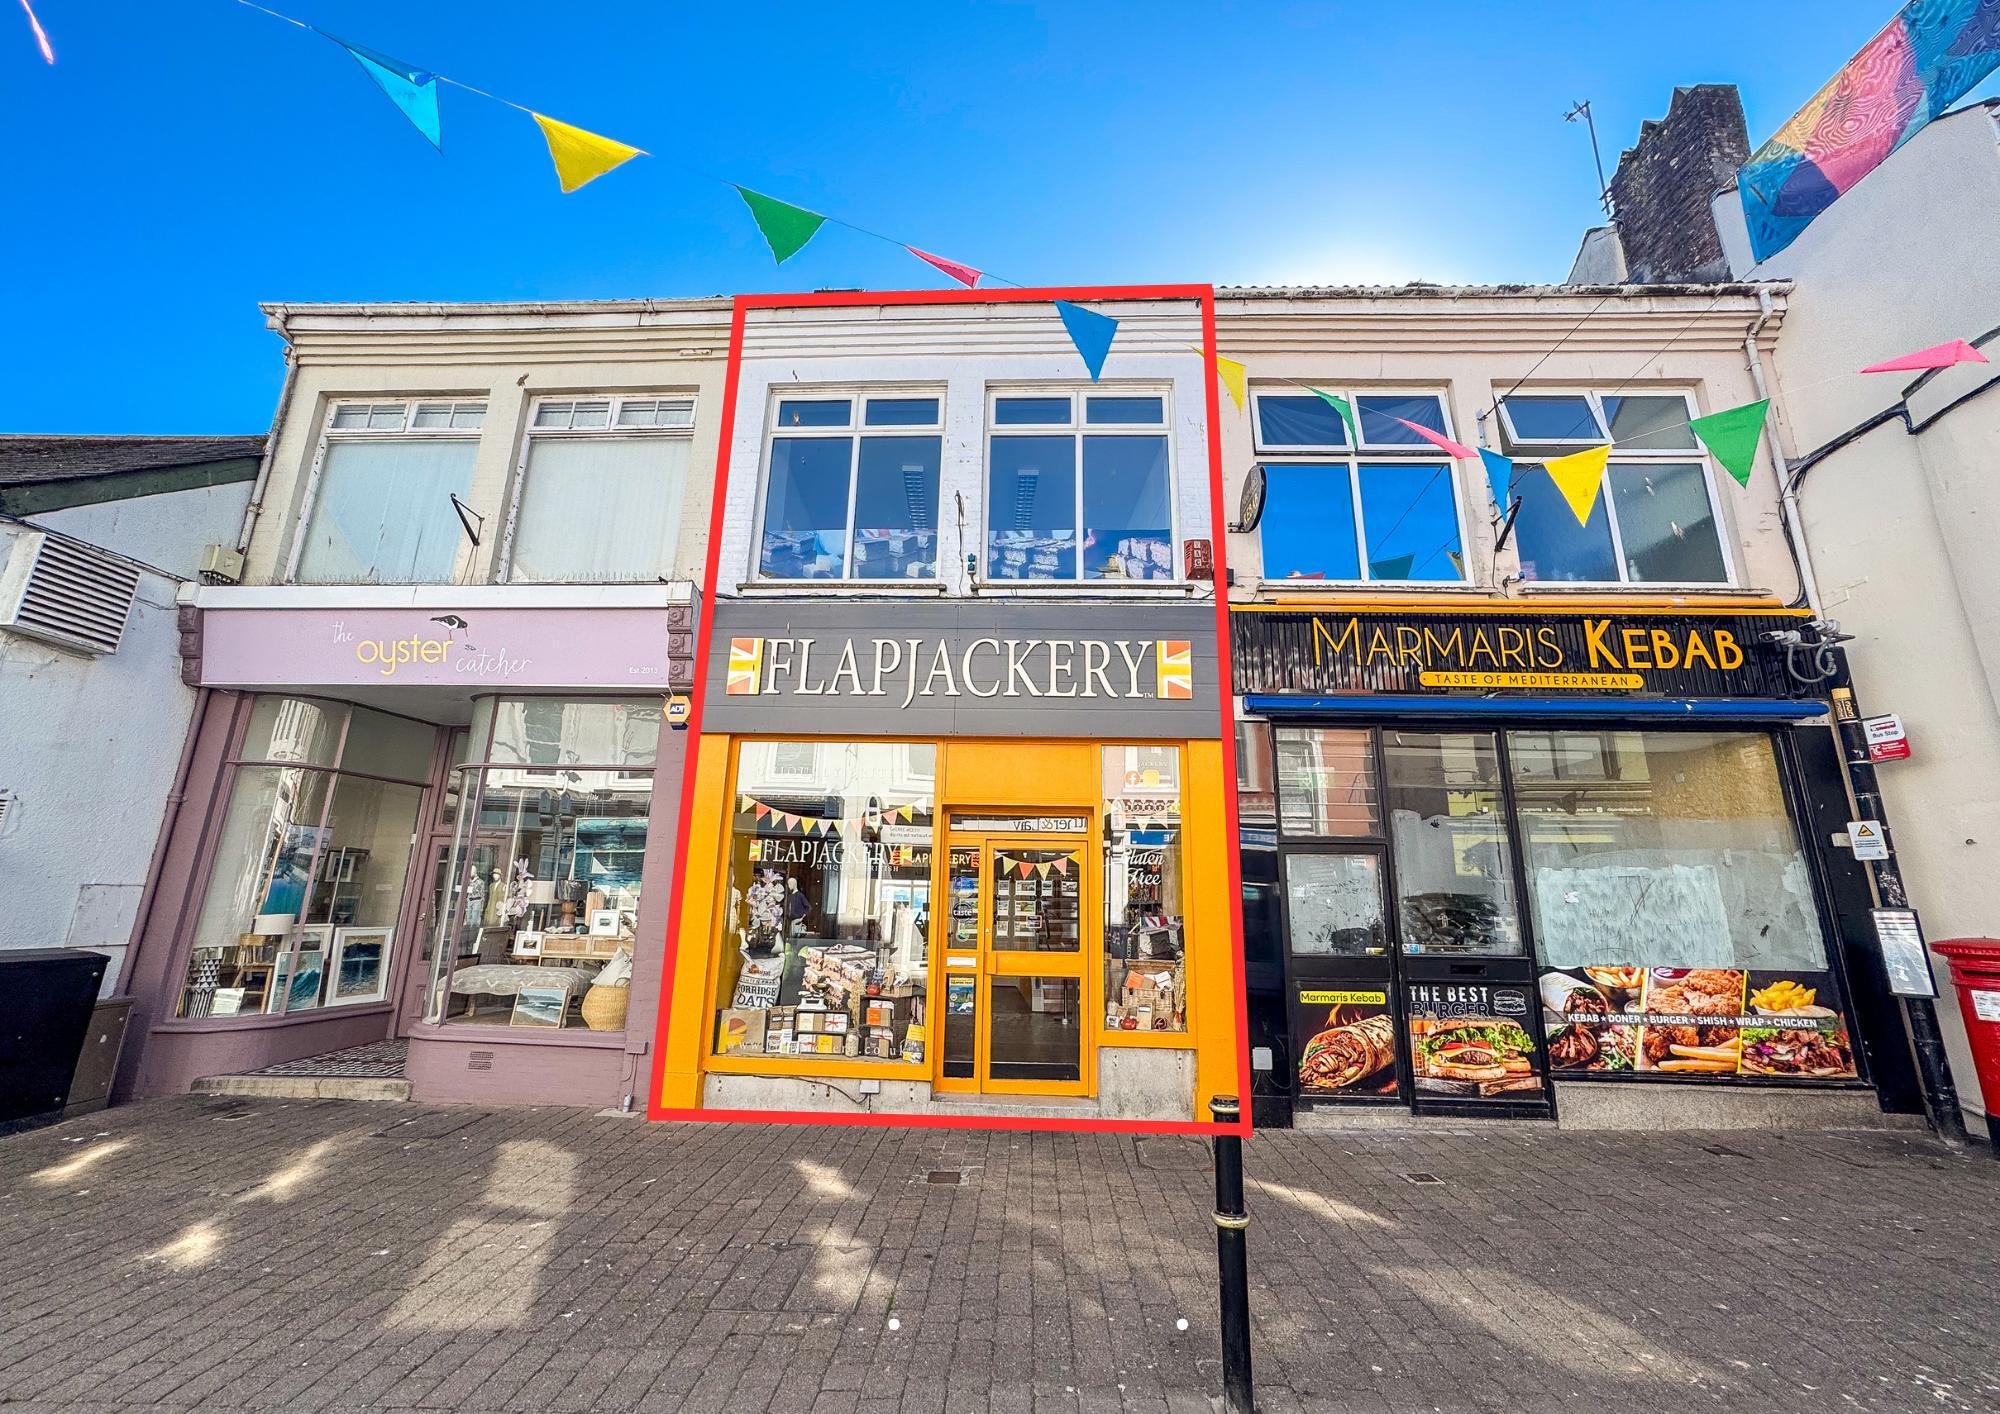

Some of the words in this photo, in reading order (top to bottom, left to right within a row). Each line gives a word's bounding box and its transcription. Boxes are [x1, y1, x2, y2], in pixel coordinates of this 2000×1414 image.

[332, 621, 354, 644] the
[1312, 616, 1563, 668] MARMARIS
[1583, 619, 1744, 671] KEBAB
[355, 633, 454, 676] oyster
[455, 647, 534, 677] catcher
[762, 638, 1152, 710] FLAPJACKERY
[1434, 673, 1478, 685] TASTE
[1483, 674, 1502, 685] OF
[1508, 674, 1630, 687] MEDITERRANEAN
[670, 704, 685, 713] ADT
[1127, 868, 1162, 886] Free
[1301, 993, 1348, 1003] Marmaris
[1350, 993, 1382, 1003] Kebab
[1409, 985, 1441, 1002] THE
[1447, 986, 1488, 1003] BEST
[1410, 1001, 1491, 1018] BURGER
[1567, 1013, 1600, 1023] KEBAB
[1608, 1014, 1642, 1024] DONER
[1649, 1015, 1688, 1025] BURGER
[1697, 1016, 1727, 1026] SHISH
[1735, 1017, 1765, 1027] WRAP
[1773, 1017, 1818, 1028] CHICKEN
